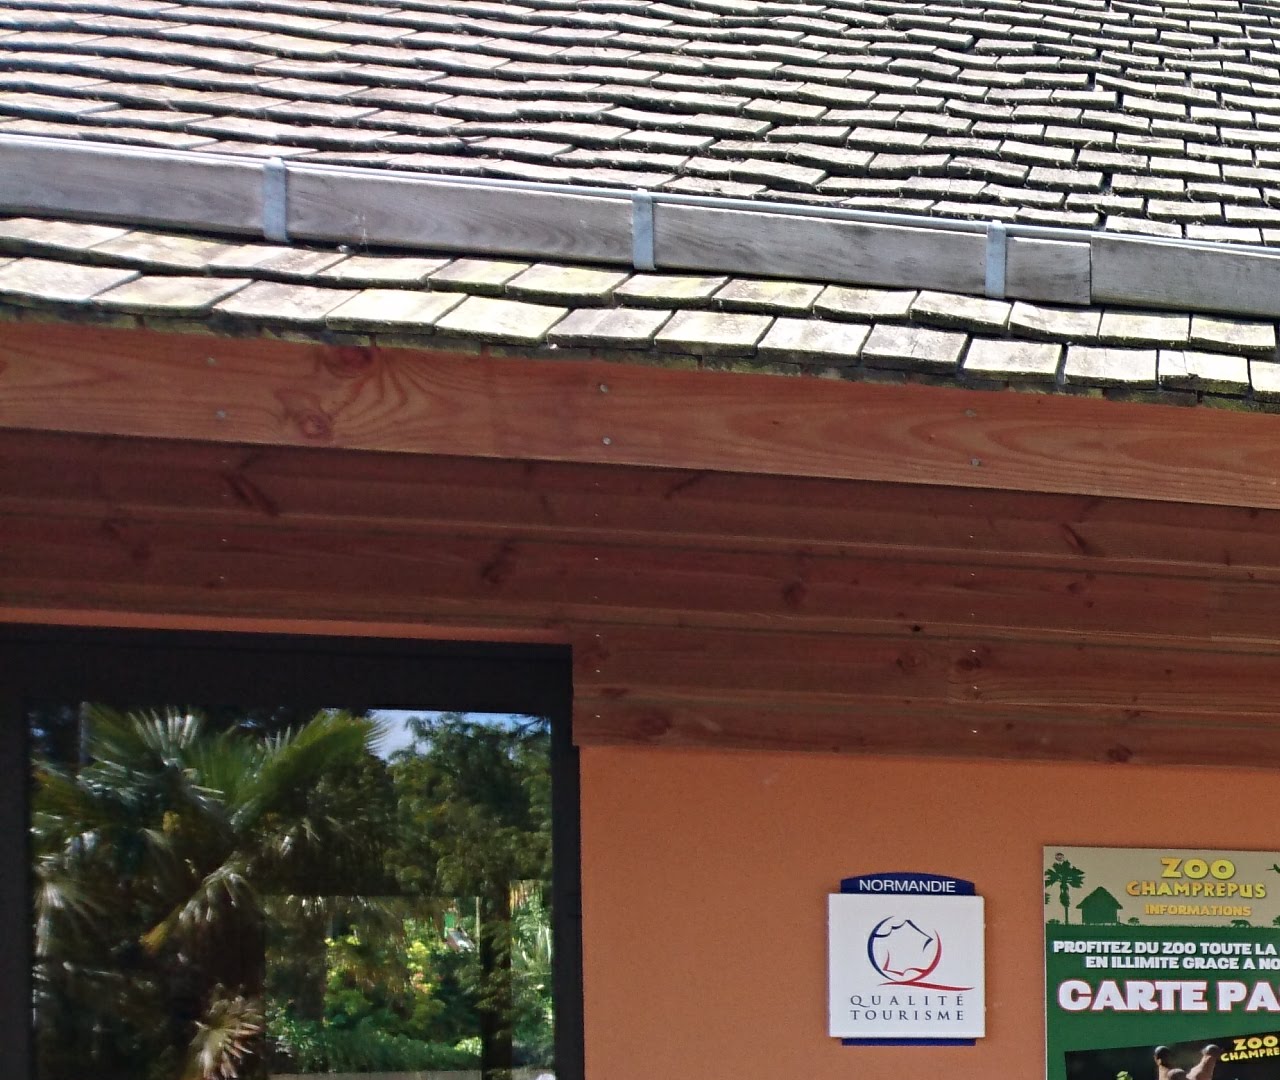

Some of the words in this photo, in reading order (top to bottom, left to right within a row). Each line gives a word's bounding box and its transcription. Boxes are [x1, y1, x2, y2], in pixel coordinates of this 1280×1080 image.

[1161, 857, 1236, 880] ZOO
[859, 879, 956, 893] NORMANDIE
[1126, 880, 1266, 898] CHAMPREPUS
[1145, 903, 1252, 917] INFORMATIONS
[1053, 940, 1133, 954] PROFITEZ
[1135, 941, 1160, 954] DU
[1162, 942, 1197, 955] ZOO
[1200, 943, 1252, 956] TOUTE
[1255, 944, 1278, 956] LA
[1085, 956, 1108, 969] EN
[1111, 957, 1180, 969] ILLIMITE
[1182, 957, 1240, 970] GRACE
[1243, 958, 1256, 970] A
[850, 994, 964, 1008] QUALITÉ
[1057, 979, 1208, 1011] CARTE
[850, 1010, 964, 1021] TOURISME
[1233, 1035, 1279, 1051] ZOO
